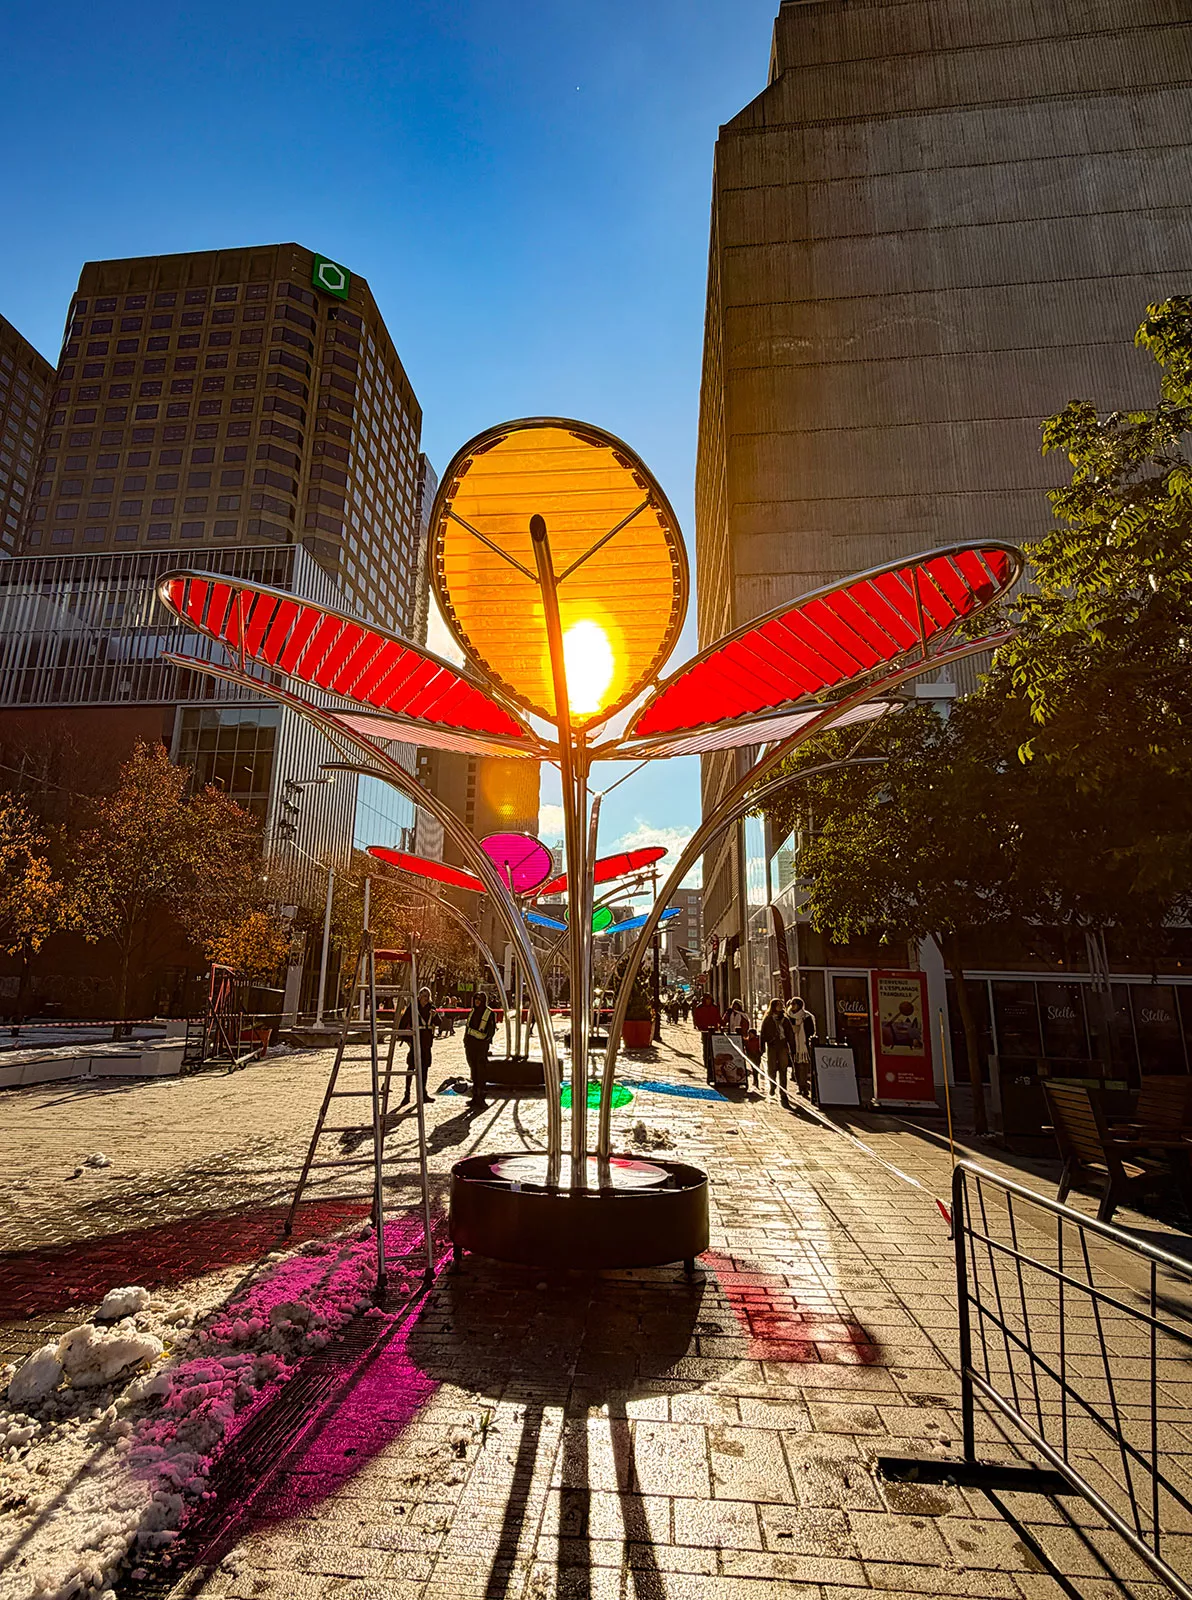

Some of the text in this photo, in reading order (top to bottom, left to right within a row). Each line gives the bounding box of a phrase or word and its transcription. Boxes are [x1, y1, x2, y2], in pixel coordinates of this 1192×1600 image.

[837, 999, 866, 1013] Stella
[1047, 1005, 1077, 1020] Stella
[1140, 1007, 1171, 1023] Stella
[820, 1055, 849, 1069] Stella
